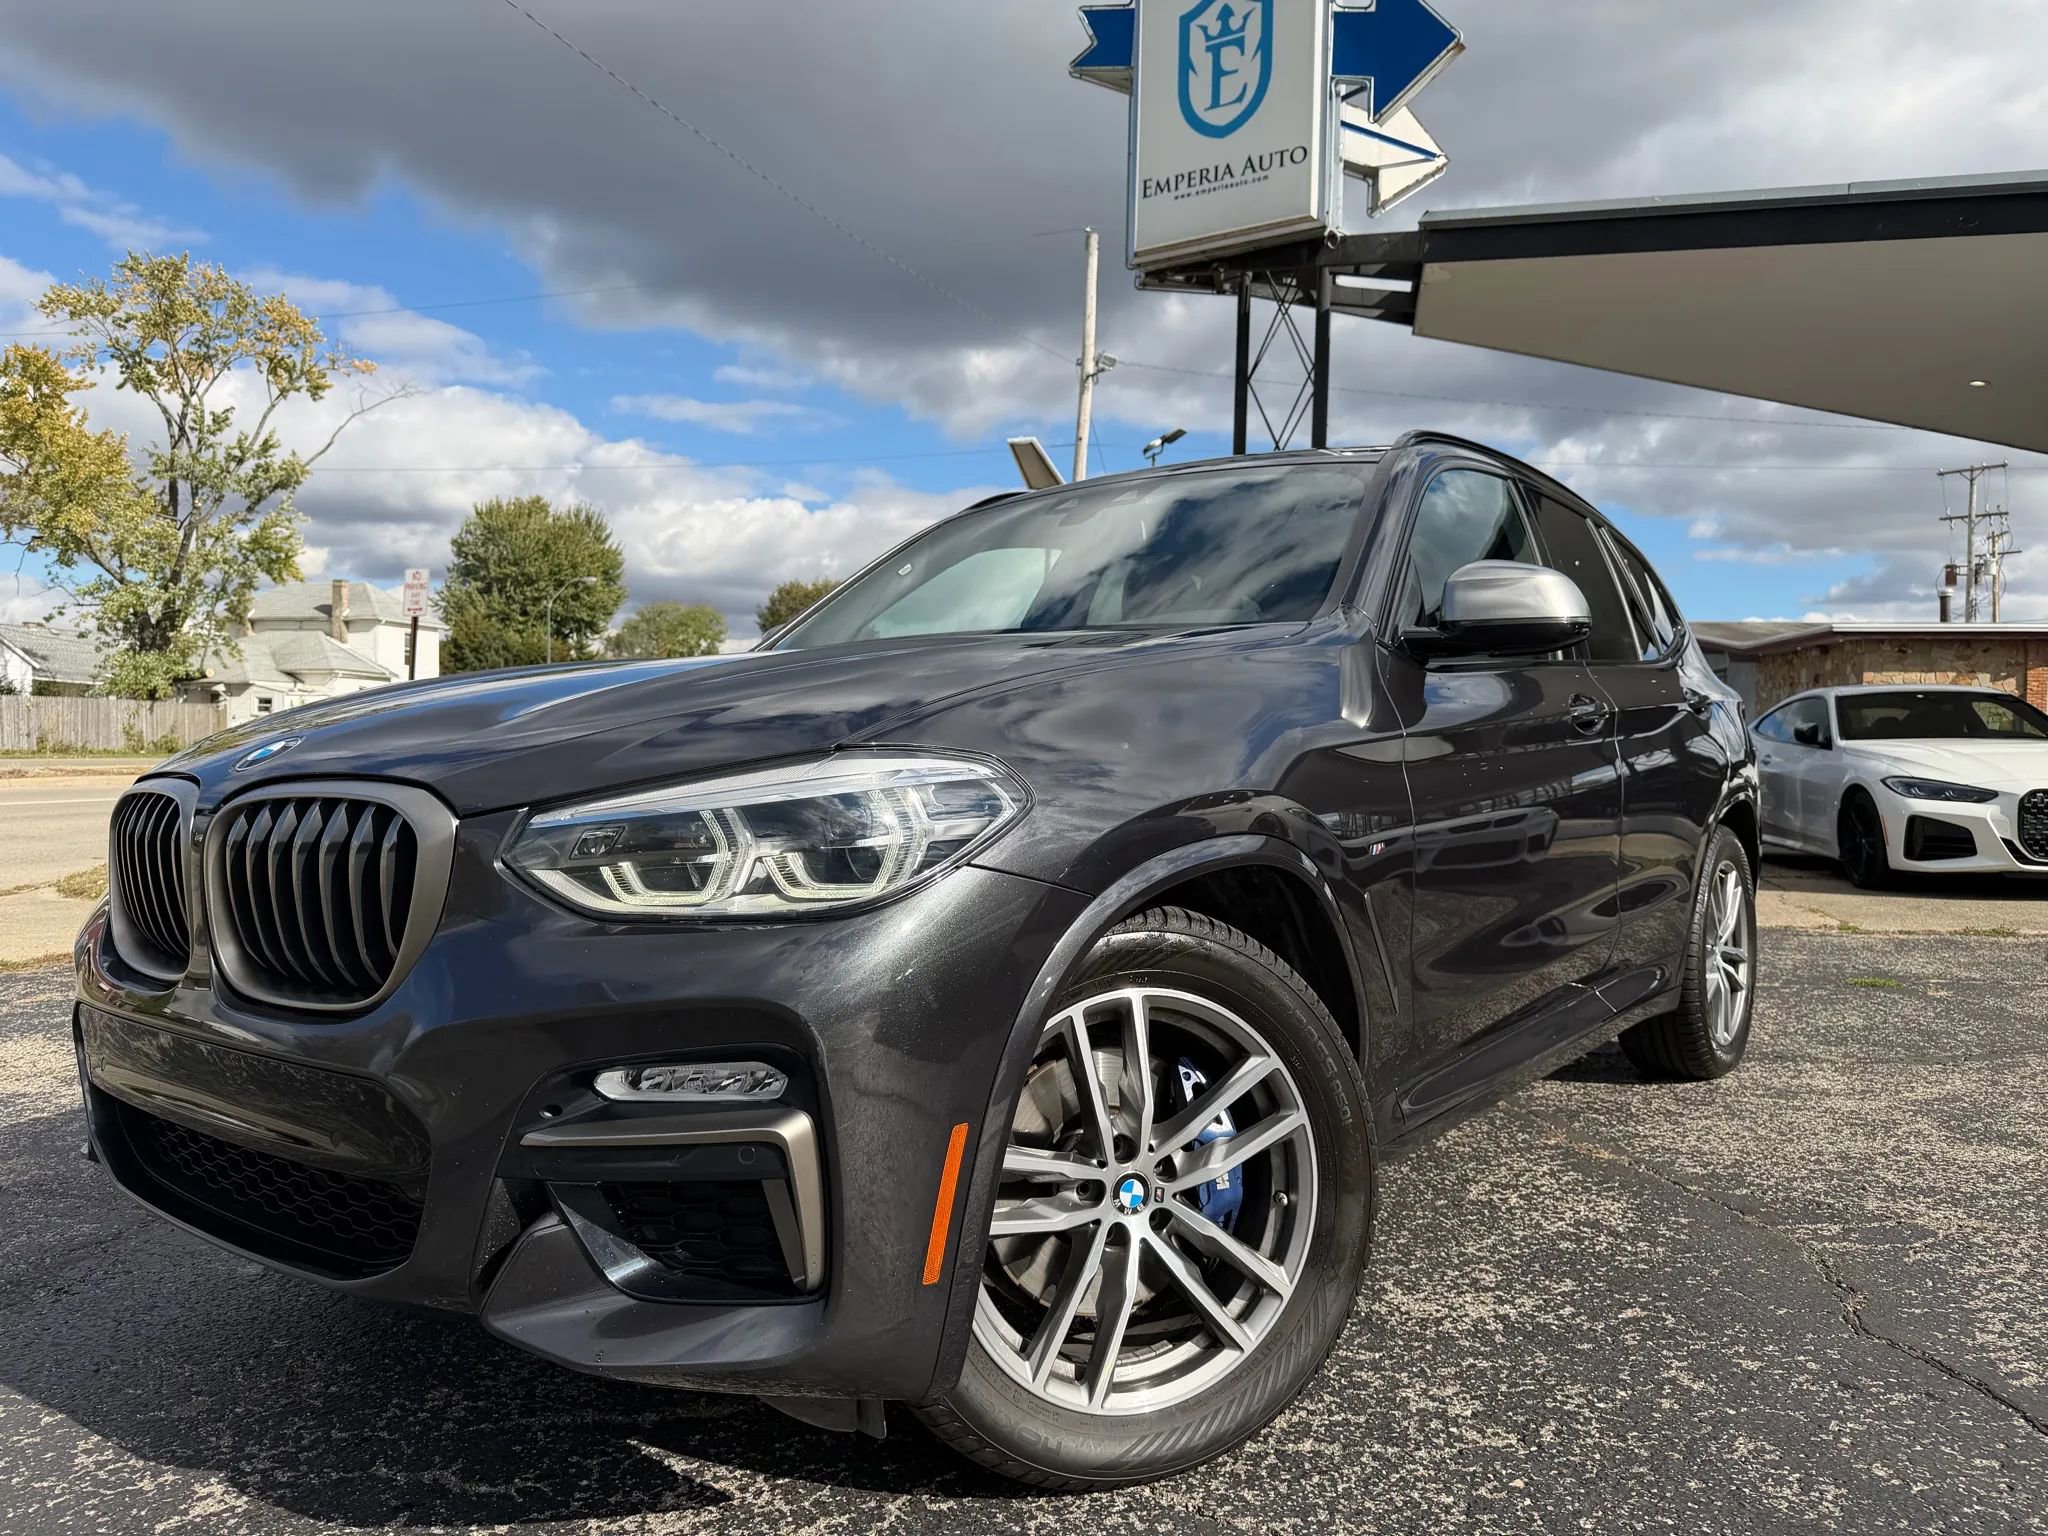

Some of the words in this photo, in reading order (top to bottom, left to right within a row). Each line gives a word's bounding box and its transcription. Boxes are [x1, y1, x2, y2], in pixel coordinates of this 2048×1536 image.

[1142, 163, 1235, 200] EMPERIA
[1241, 145, 1308, 177] AUTO
[1174, 174, 1270, 201] www.emperiaauto.com
[1113, 1198, 1146, 1215] BMW
